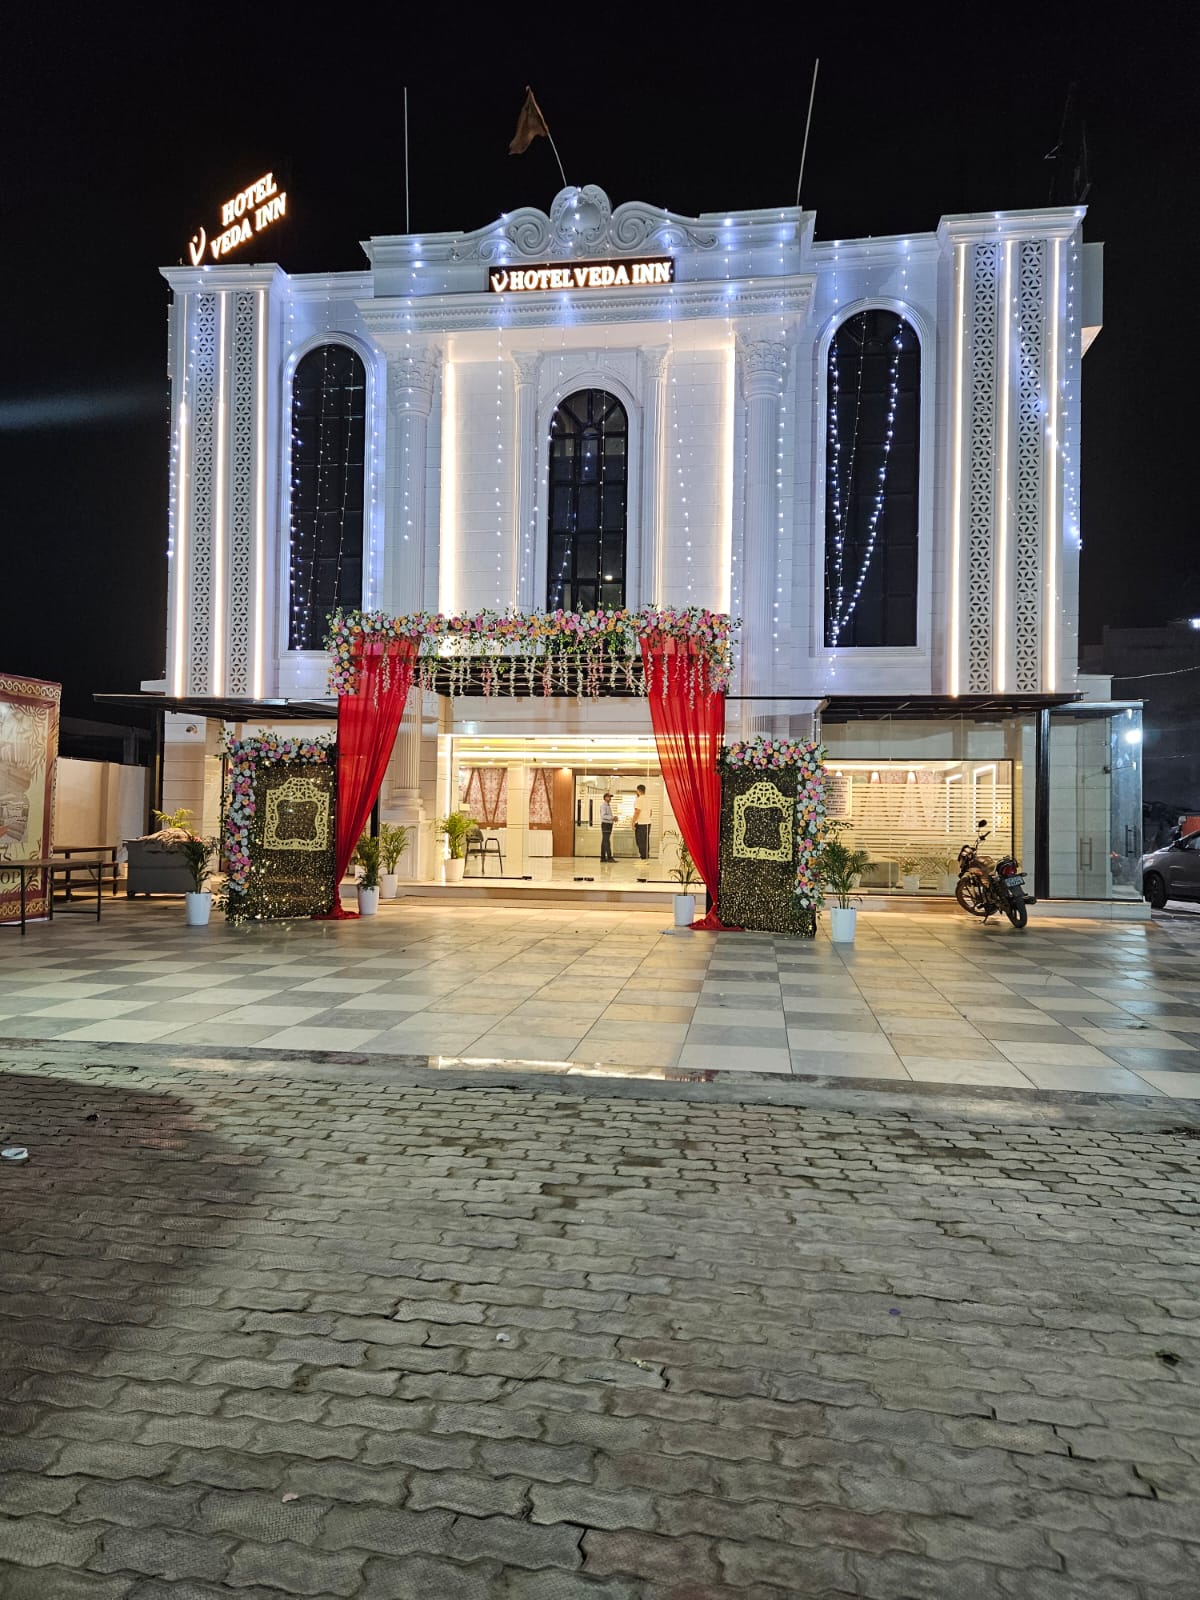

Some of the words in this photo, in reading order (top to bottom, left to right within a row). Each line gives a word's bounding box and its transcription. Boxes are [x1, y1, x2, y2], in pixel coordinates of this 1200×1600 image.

[210, 218, 253, 259] VEDA
[255, 192, 287, 232] INN
[221, 172, 278, 226] HOTEL
[510, 269, 574, 290] HOTEL
[574, 265, 630, 288] VEDA
[632, 262, 672, 284] INN
